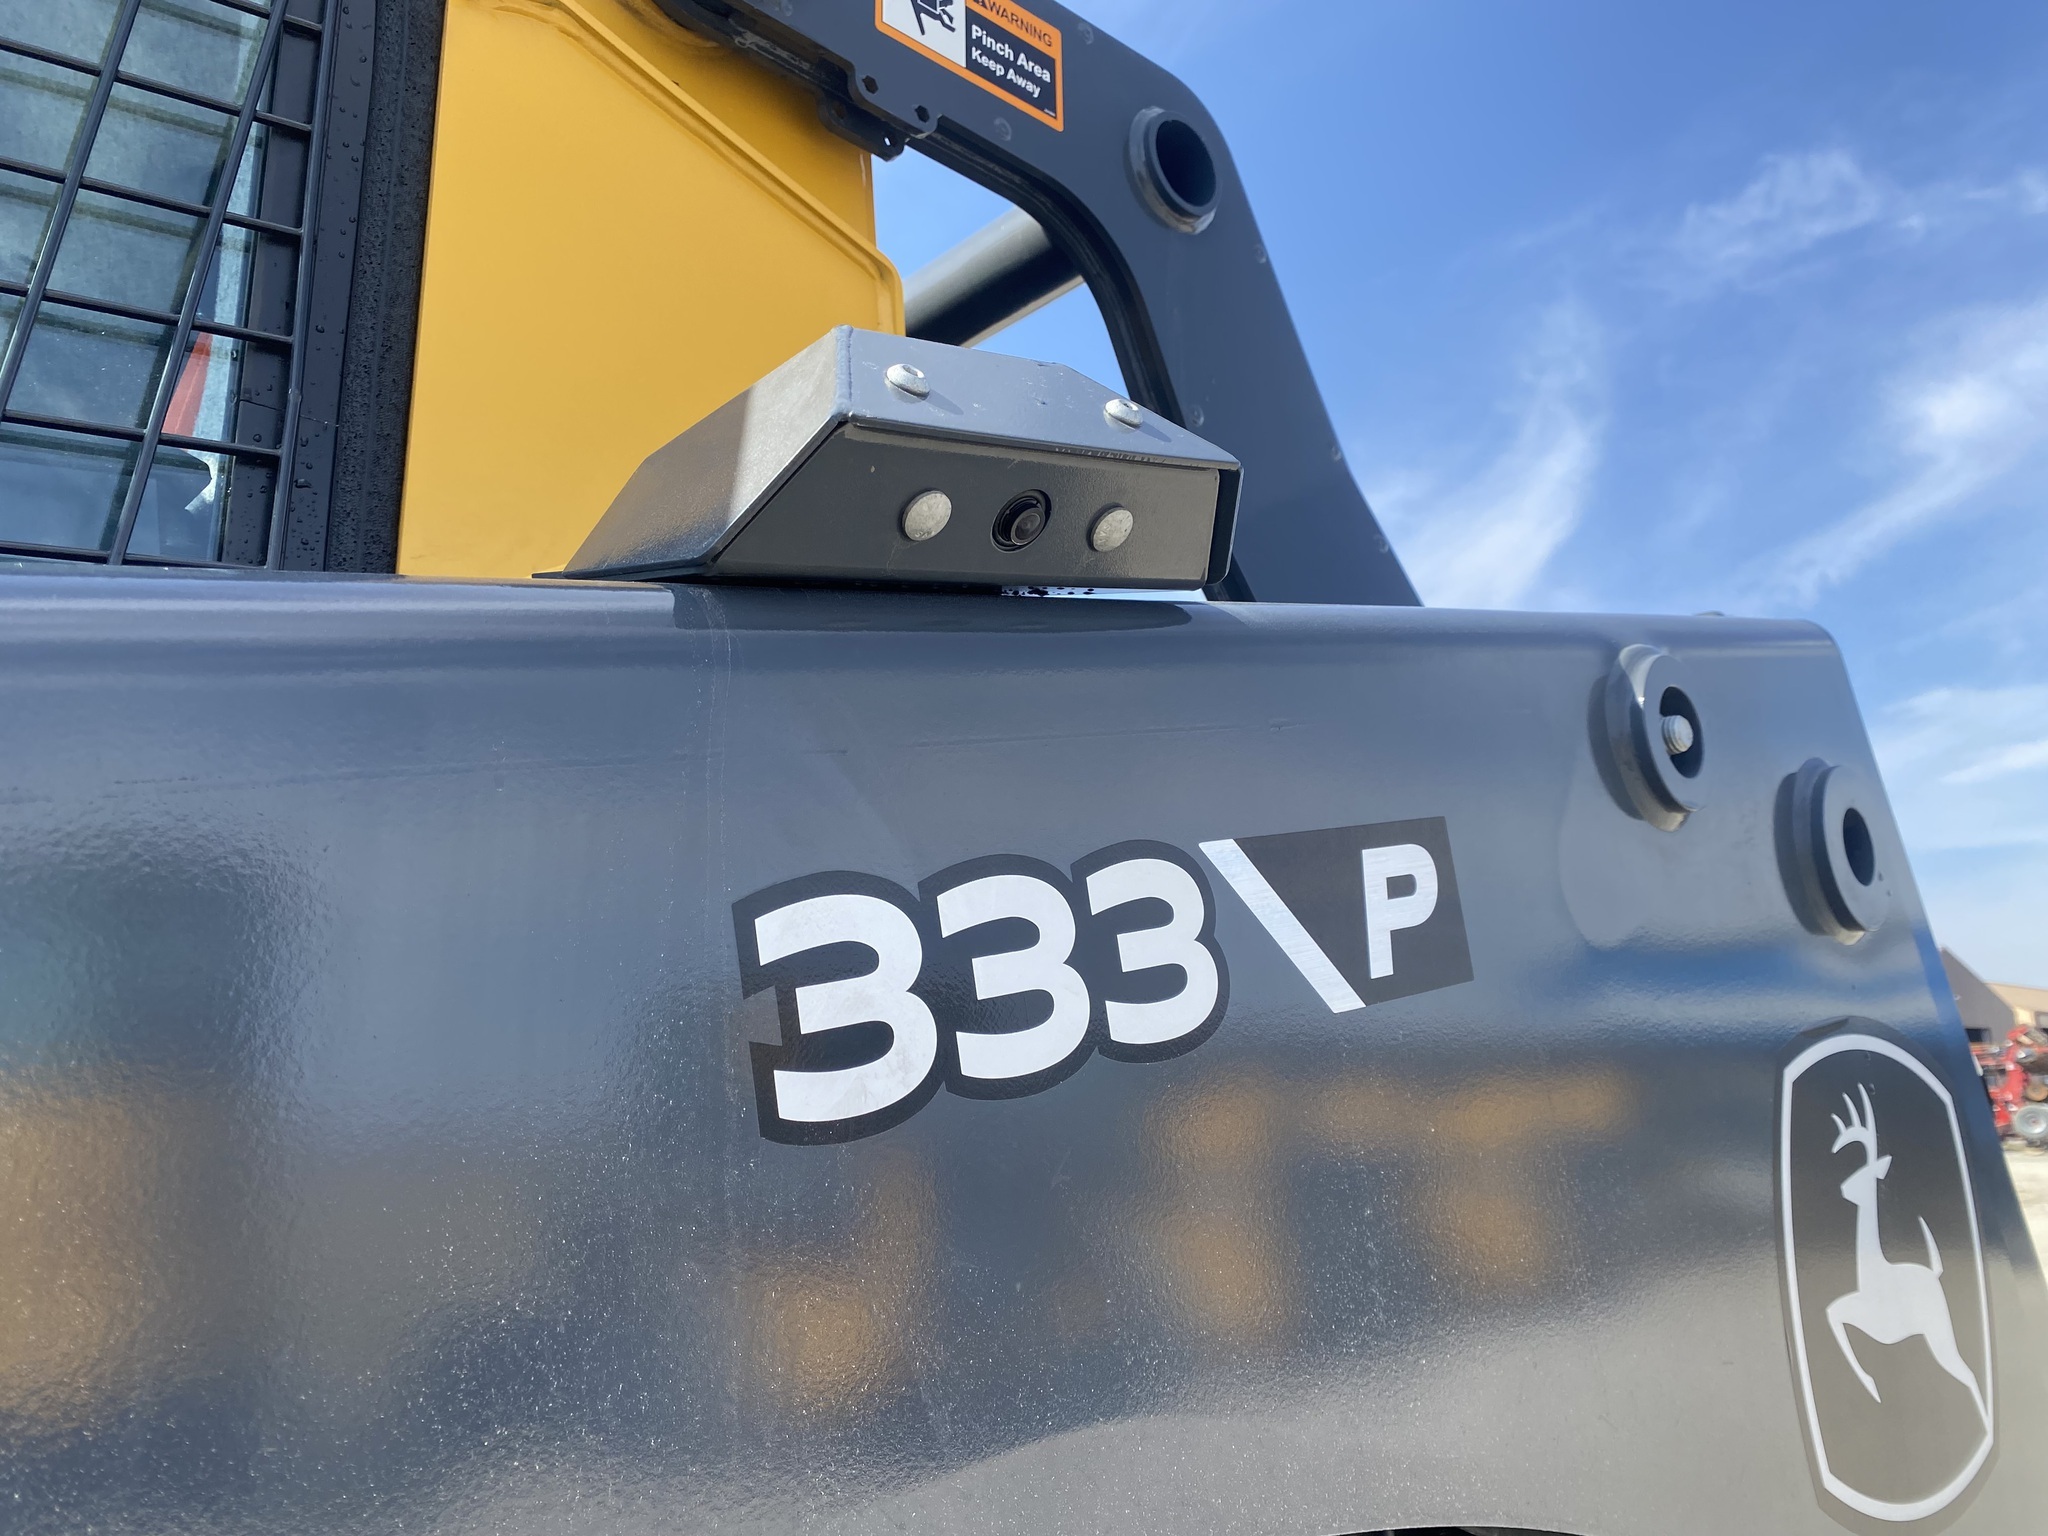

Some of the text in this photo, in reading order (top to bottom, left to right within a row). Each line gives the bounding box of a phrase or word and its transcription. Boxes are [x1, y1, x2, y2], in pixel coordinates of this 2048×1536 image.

[987, 0, 1053, 47] WARNING
[971, 24, 1051, 83] Pinch Area
[971, 46, 1041, 98] Keep Away
[754, 843, 1439, 1123] 333 P
